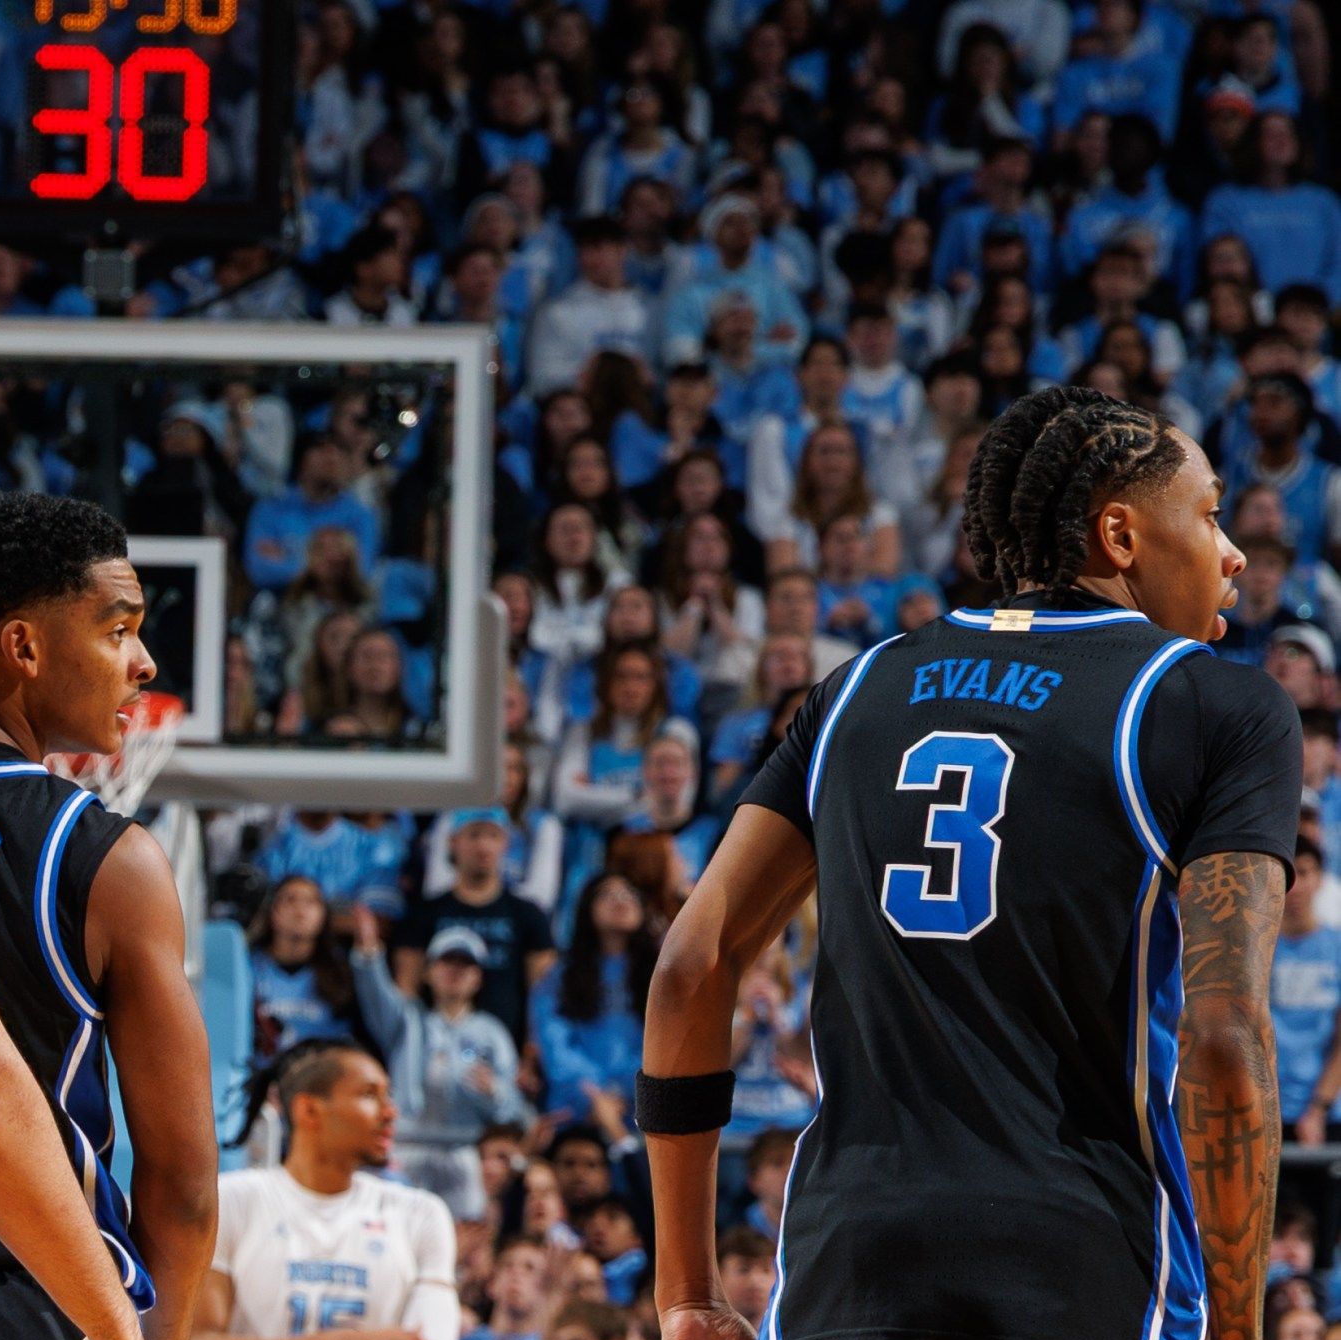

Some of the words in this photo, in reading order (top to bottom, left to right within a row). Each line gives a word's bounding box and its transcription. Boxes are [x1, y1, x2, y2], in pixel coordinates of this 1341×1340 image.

[30, 44, 210, 201] 30
[908, 658, 1063, 712] EVANS
[880, 730, 1016, 941] 3
